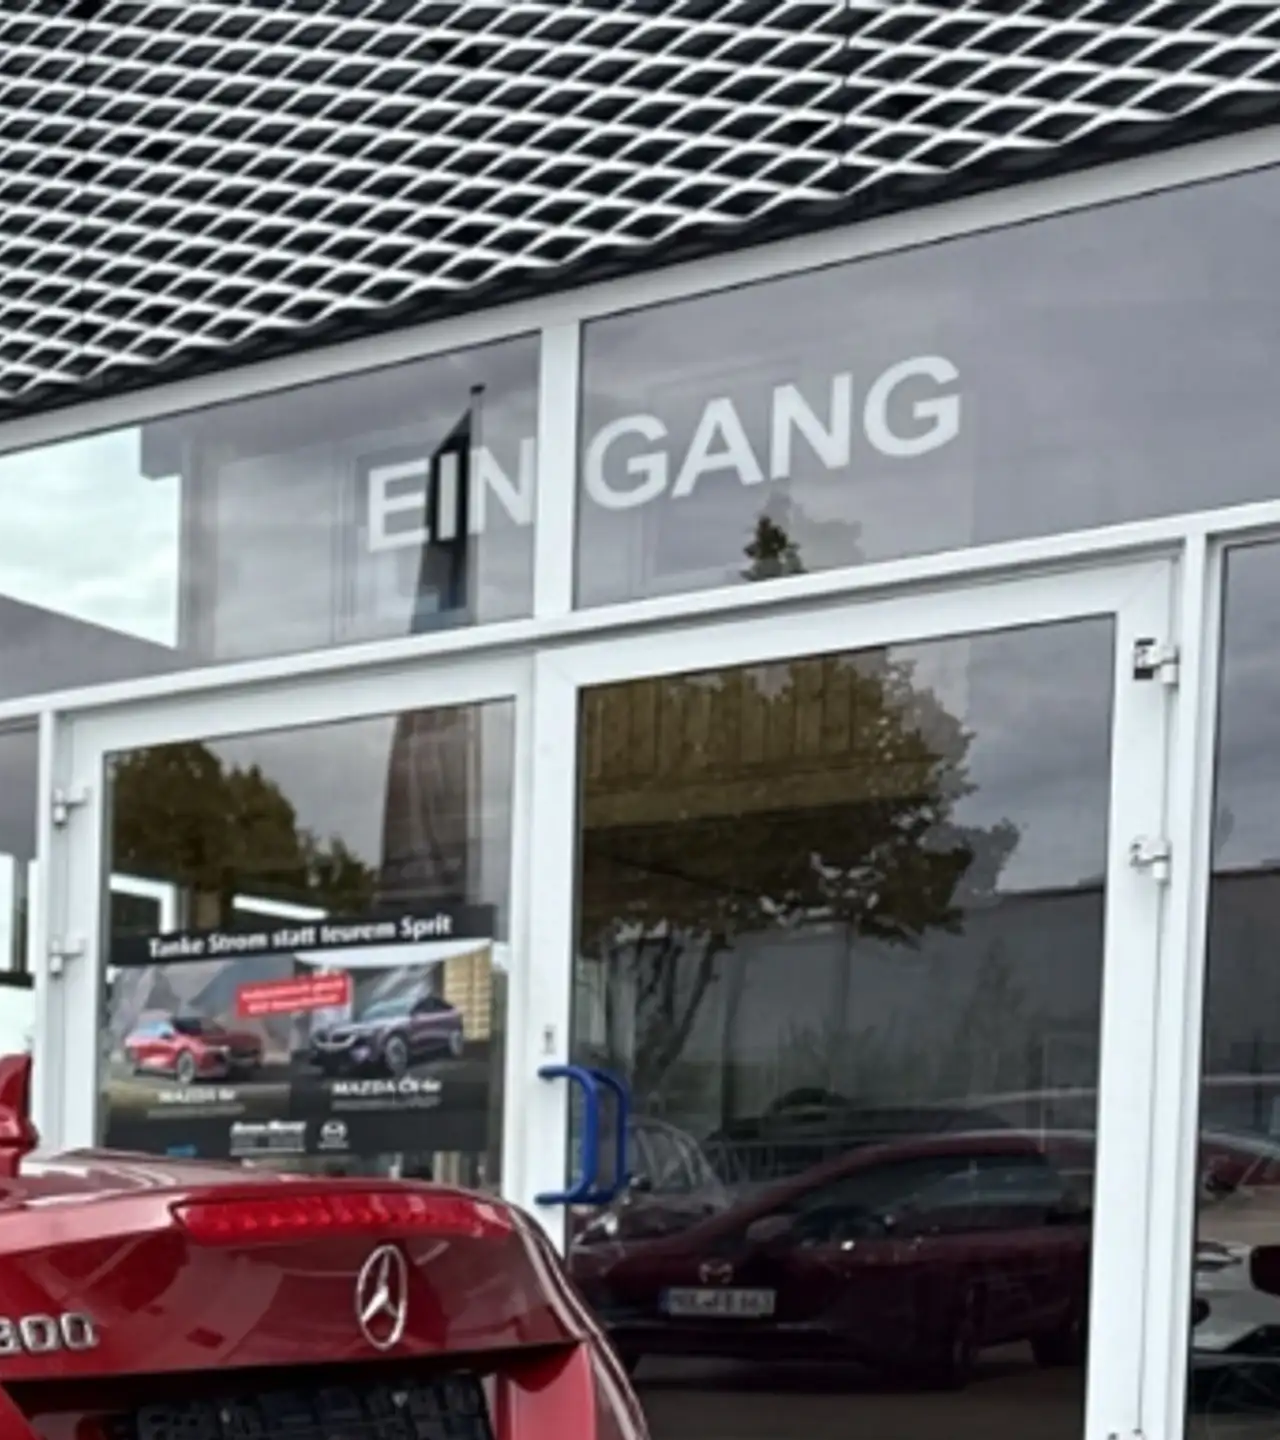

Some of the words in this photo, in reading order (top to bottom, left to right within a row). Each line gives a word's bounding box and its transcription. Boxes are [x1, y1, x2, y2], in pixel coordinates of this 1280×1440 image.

[368, 356, 960, 552] EINGANG
[149, 938, 204, 958] Tanke
[209, 932, 268, 953] Strom
[272, 925, 316, 948] statt
[320, 920, 397, 944] teurem
[401, 913, 453, 941] Sprit
